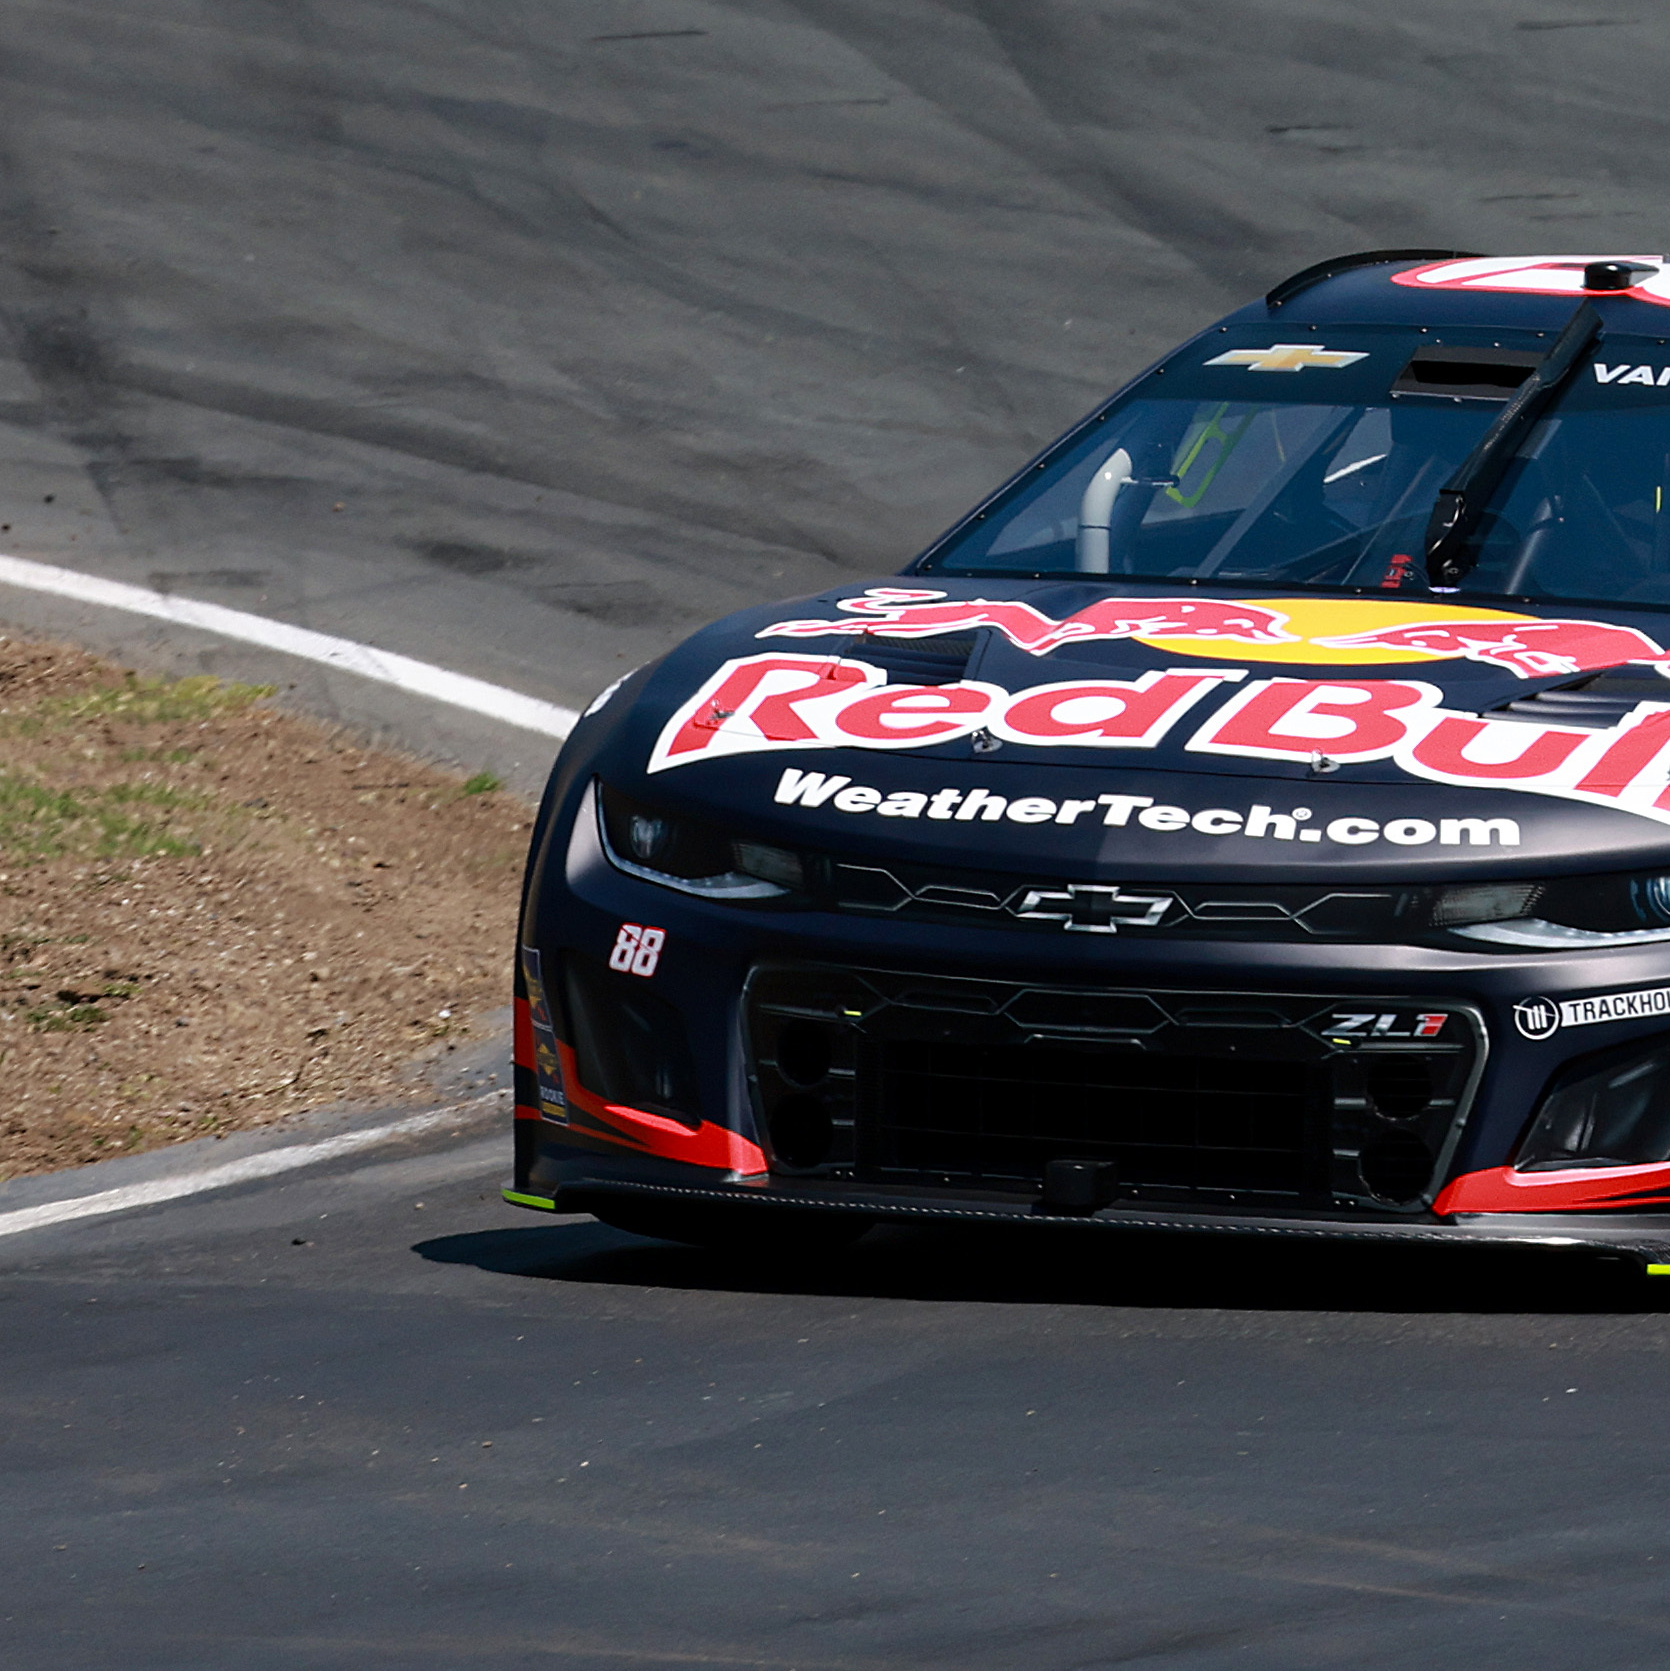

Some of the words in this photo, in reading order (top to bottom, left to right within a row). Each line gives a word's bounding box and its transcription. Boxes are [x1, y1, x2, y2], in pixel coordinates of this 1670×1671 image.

[647, 652, 1249, 774] Red
[609, 922, 667, 977] 88
[1321, 1013, 1448, 1037] ZL1
